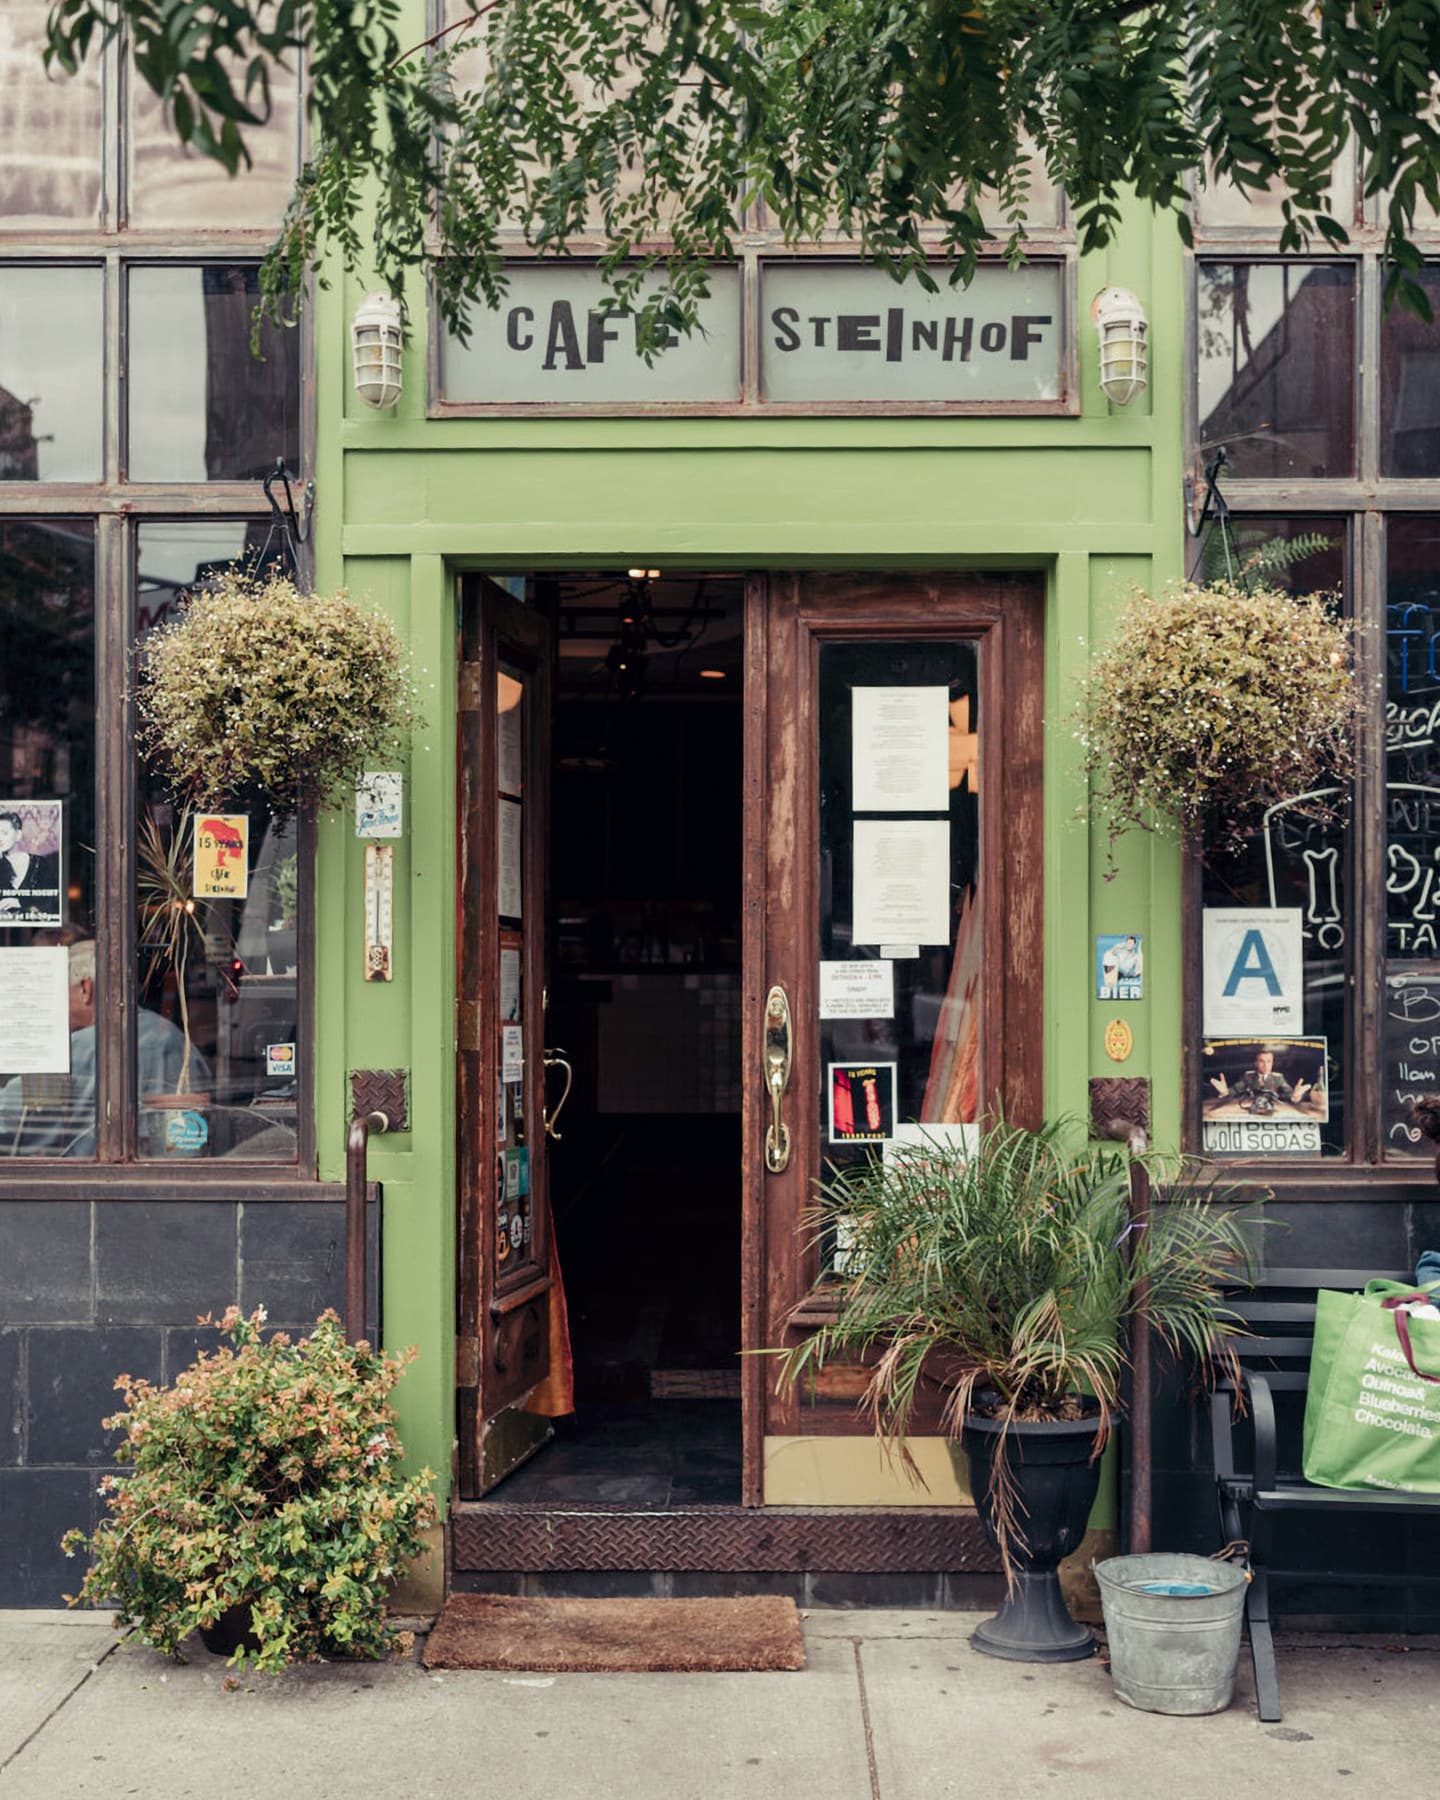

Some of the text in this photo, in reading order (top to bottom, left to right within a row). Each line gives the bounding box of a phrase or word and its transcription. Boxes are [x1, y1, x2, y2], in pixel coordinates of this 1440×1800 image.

[771, 306, 1053, 363] STEINHOF
[199, 837, 211, 849] 15
[1222, 929, 1283, 997] A
[1100, 986, 1141, 999] BIER
[272, 1063, 292, 1072] VISA
[1246, 1133, 1317, 1150] SODAS
